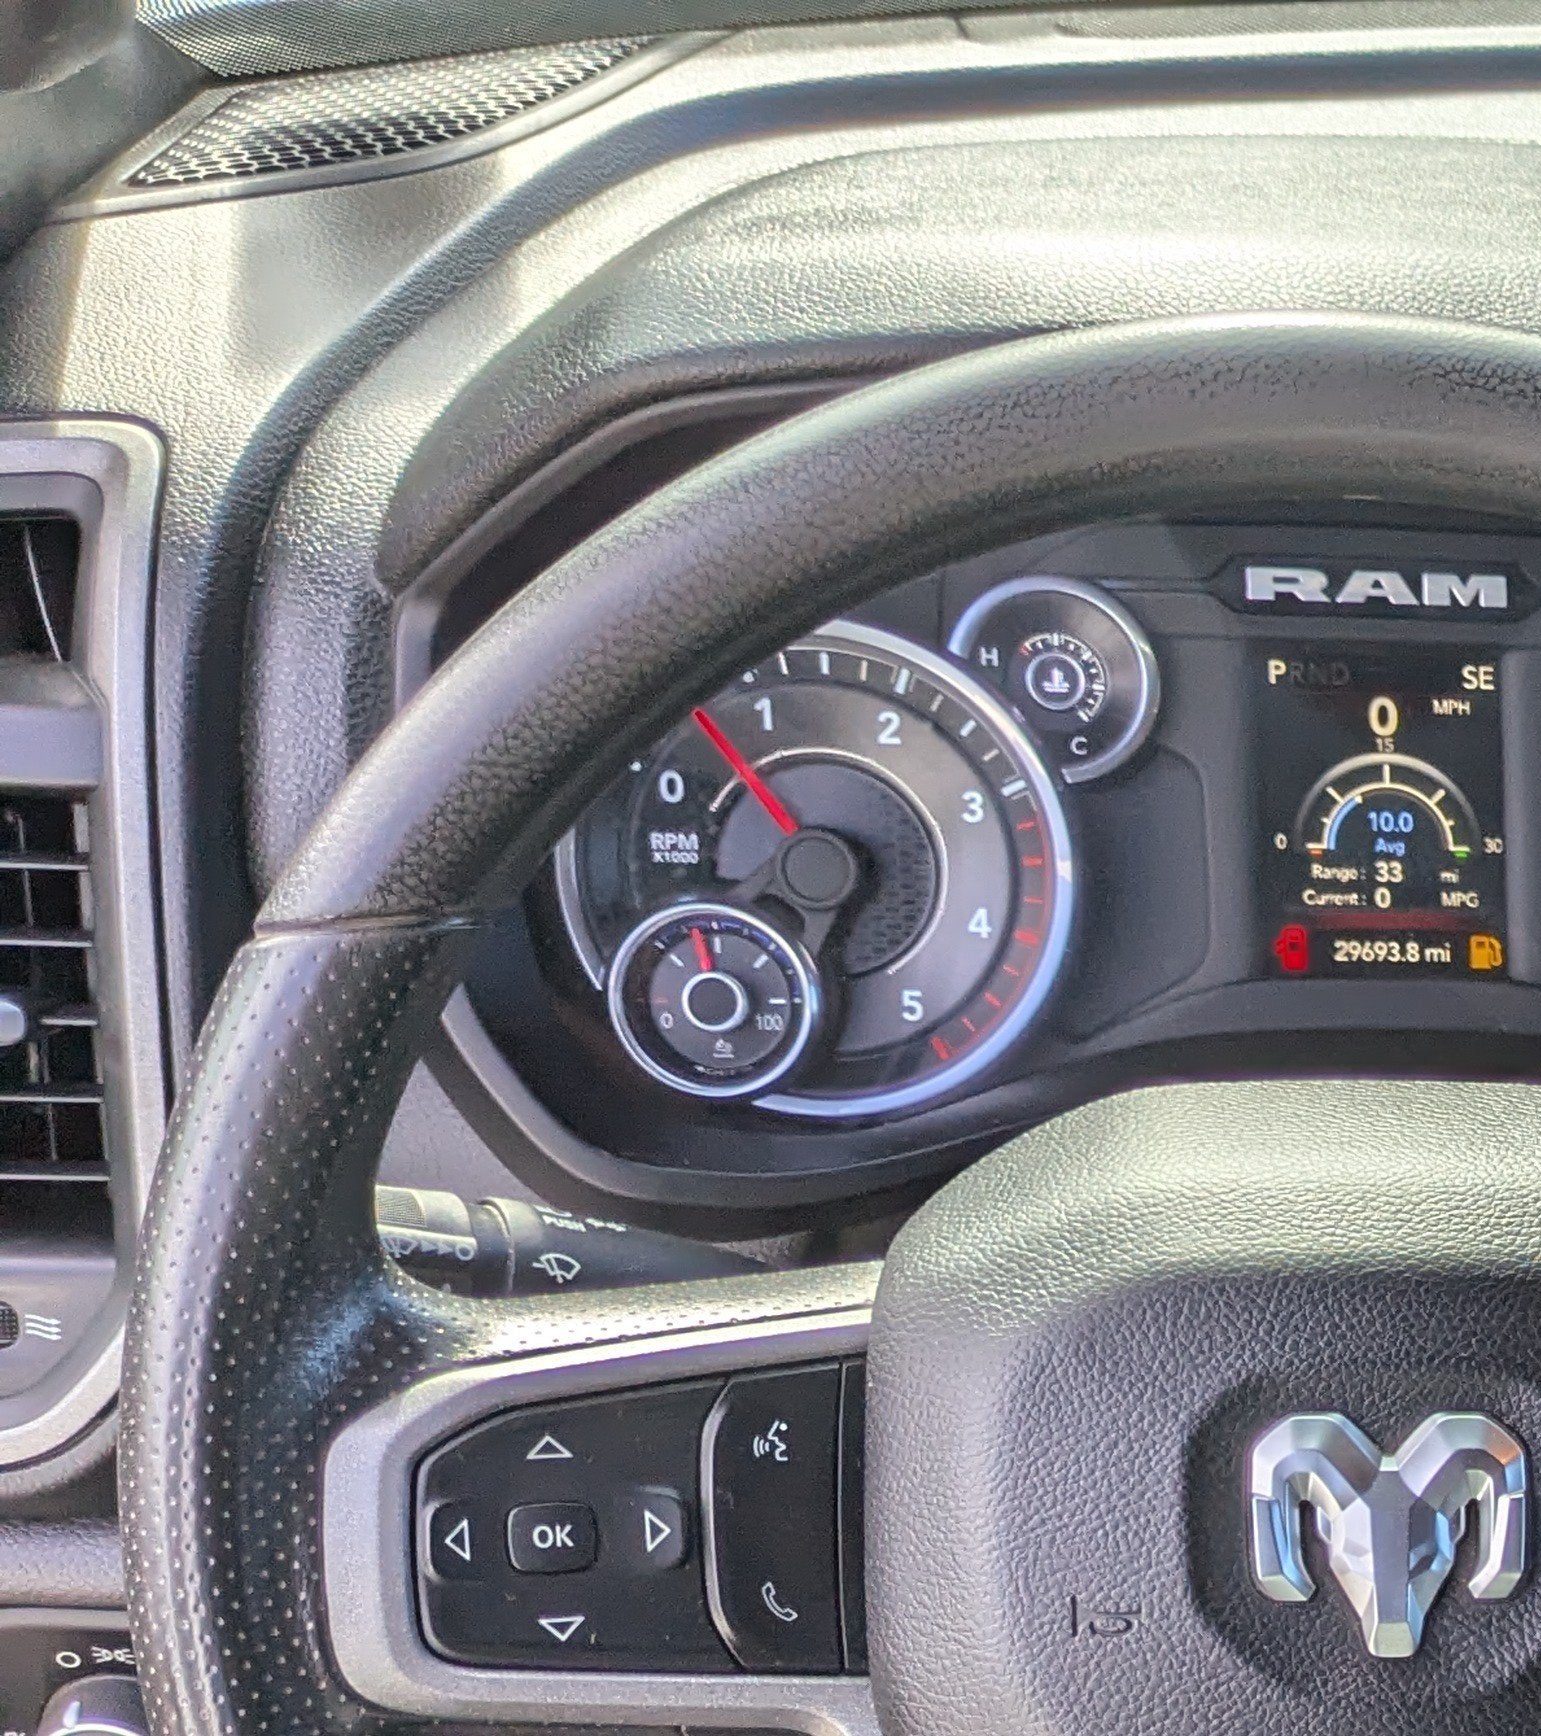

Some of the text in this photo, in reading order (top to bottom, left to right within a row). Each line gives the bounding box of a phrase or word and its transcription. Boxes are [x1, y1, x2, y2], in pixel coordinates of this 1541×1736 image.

[1246, 566, 1508, 608] RAM
[980, 646, 998, 667] H
[1462, 666, 1495, 690] SE
[754, 698, 775, 731] 1
[1368, 697, 1398, 736] 0
[1433, 700, 1470, 716] MPH
[878, 711, 902, 746] 2
[1070, 736, 1088, 756] C
[1376, 738, 1395, 753] 15
[659, 769, 685, 803] 0
[961, 791, 984, 824] 3
[1368, 812, 1414, 832] 10.0
[650, 832, 700, 850] RPM
[1274, 834, 1288, 850] 0
[1374, 840, 1405, 857] Avg
[1484, 838, 1503, 854] 30
[1375, 862, 1402, 882] 33
[1440, 869, 1459, 883] mi
[1374, 890, 1391, 908] 0
[1440, 892, 1480, 908] MPG
[968, 907, 992, 939] 4
[1334, 941, 1452, 962] 29693.8 mi
[902, 990, 924, 1023] 5
[659, 1012, 674, 1029] 0
[755, 1014, 784, 1032] 100
[532, 1523, 575, 1549] OK
